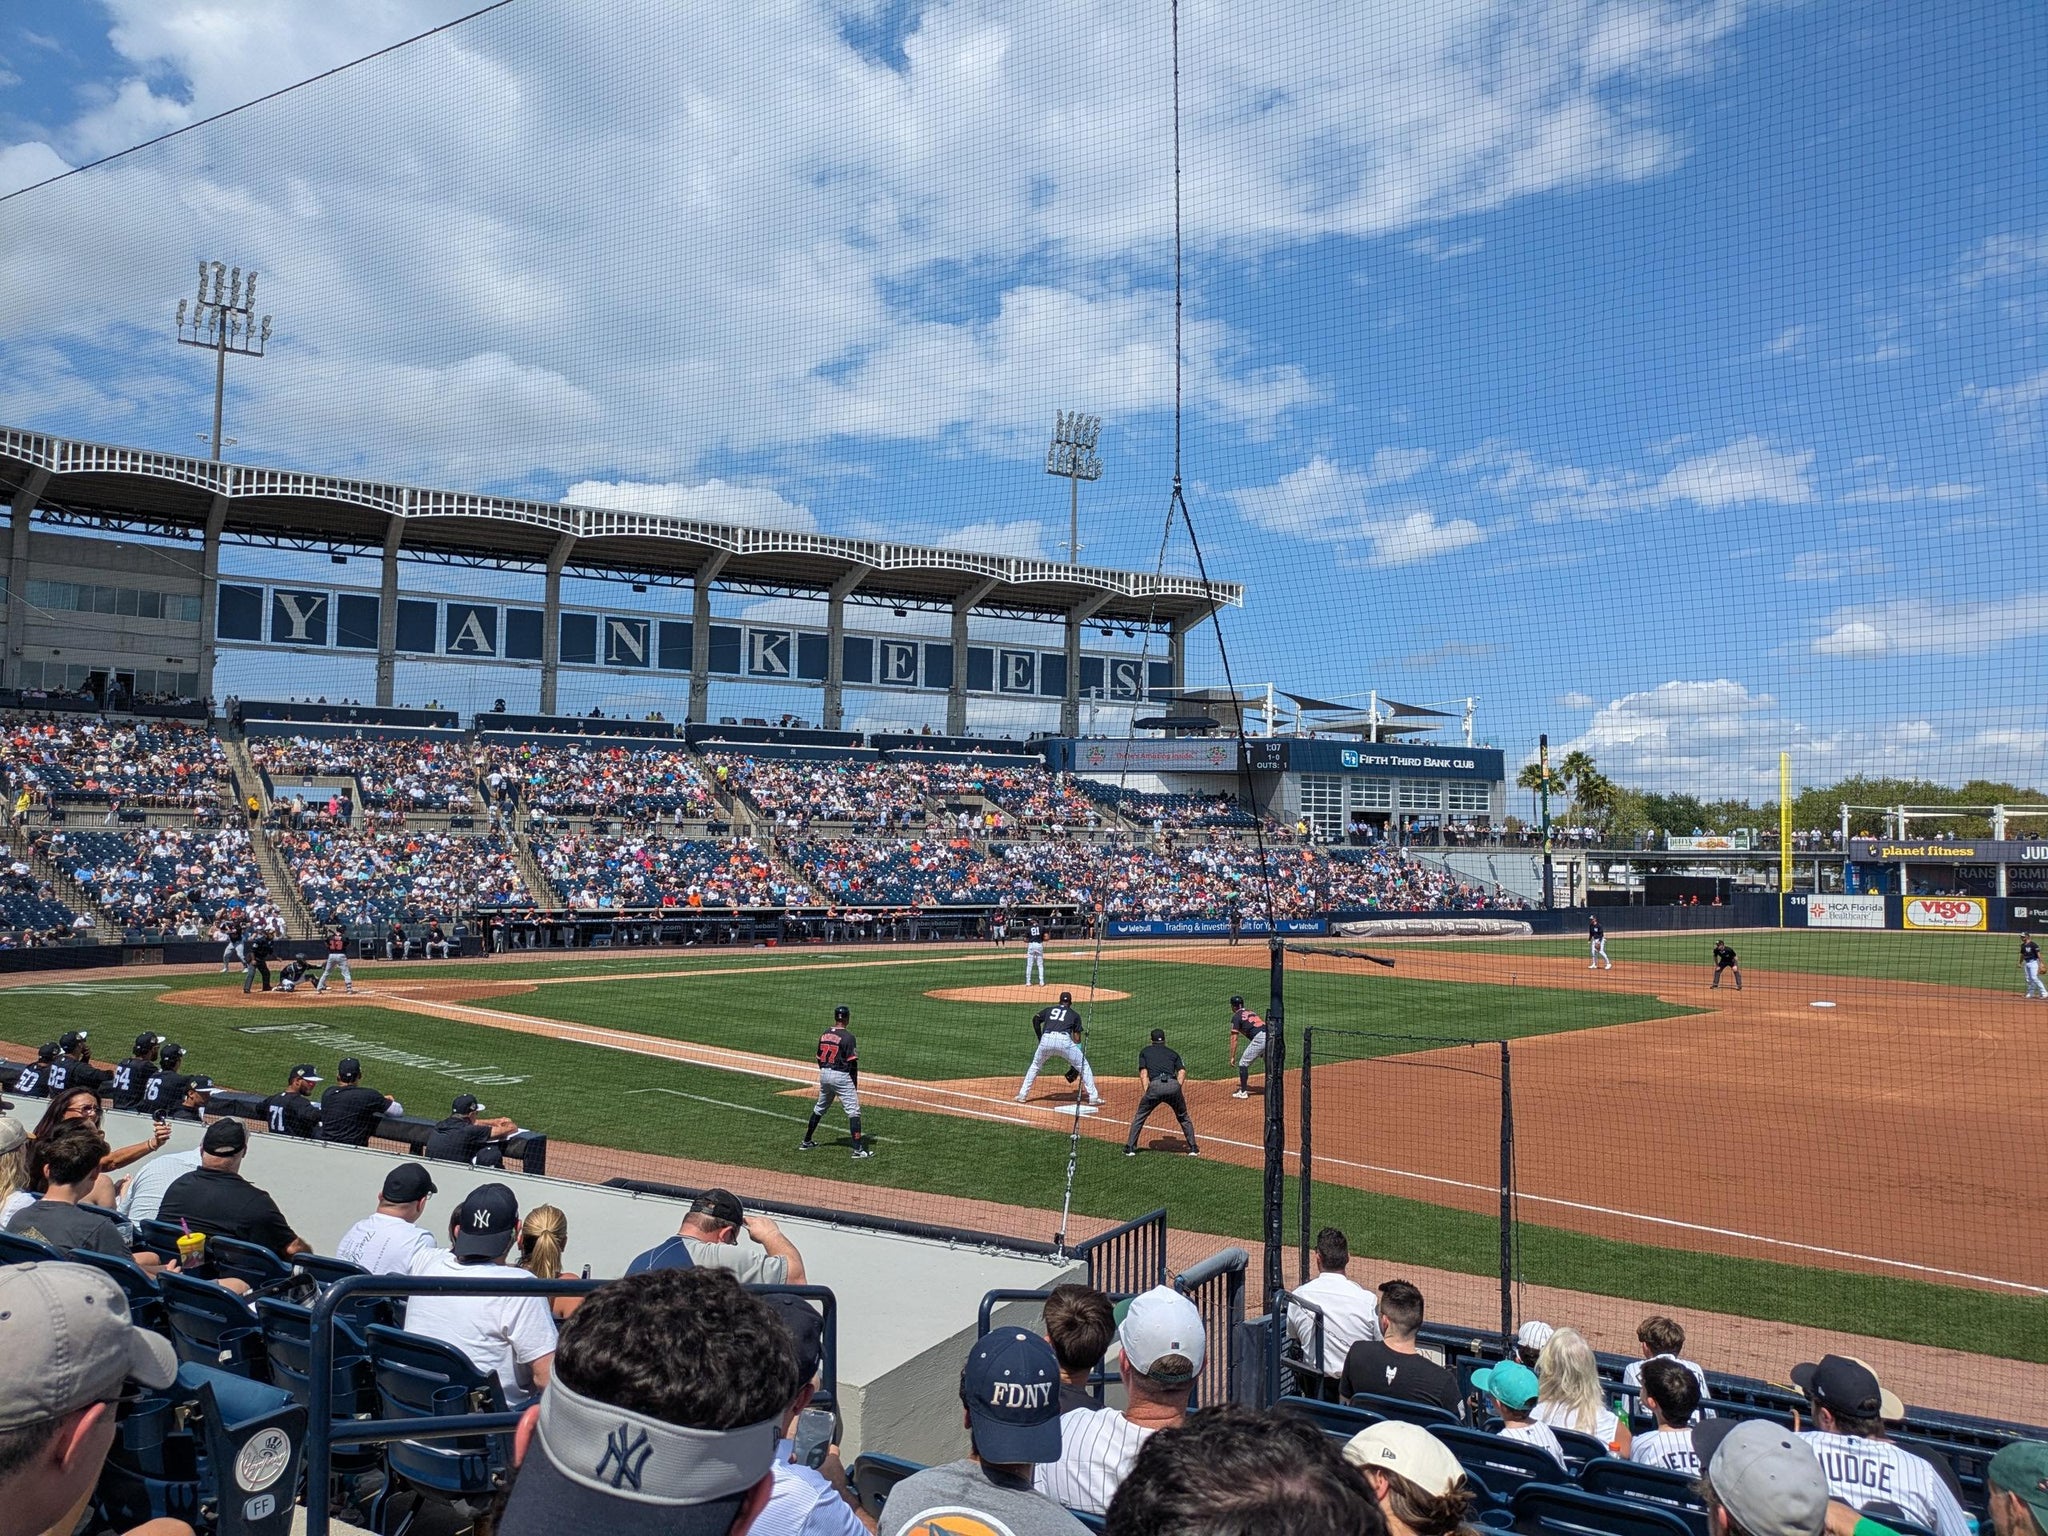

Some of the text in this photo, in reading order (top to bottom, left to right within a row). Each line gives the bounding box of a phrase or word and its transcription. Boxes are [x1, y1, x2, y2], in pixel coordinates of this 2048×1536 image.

[1266, 743, 1281, 751] 1:07
[1359, 754, 1475, 769] FIFTH THIRD BANK CLUB
[1882, 845, 1974, 858] planet fitness
[1791, 897, 1806, 905] 318
[1029, 927, 1040, 936] 81
[1128, 924, 1151, 932] Webull
[1164, 923, 1193, 932] Trading
[1194, 922, 1201, 931] &
[1201, 922, 1231, 931] Investin
[1253, 921, 1264, 930] for
[1298, 922, 1319, 930] Webull
[1050, 1007, 1067, 1021] 91
[820, 1043, 839, 1063] 77
[268, 1104, 285, 1132] 71
[990, 1381, 1053, 1409] FDNY
[253, 1499, 269, 1516] FF
